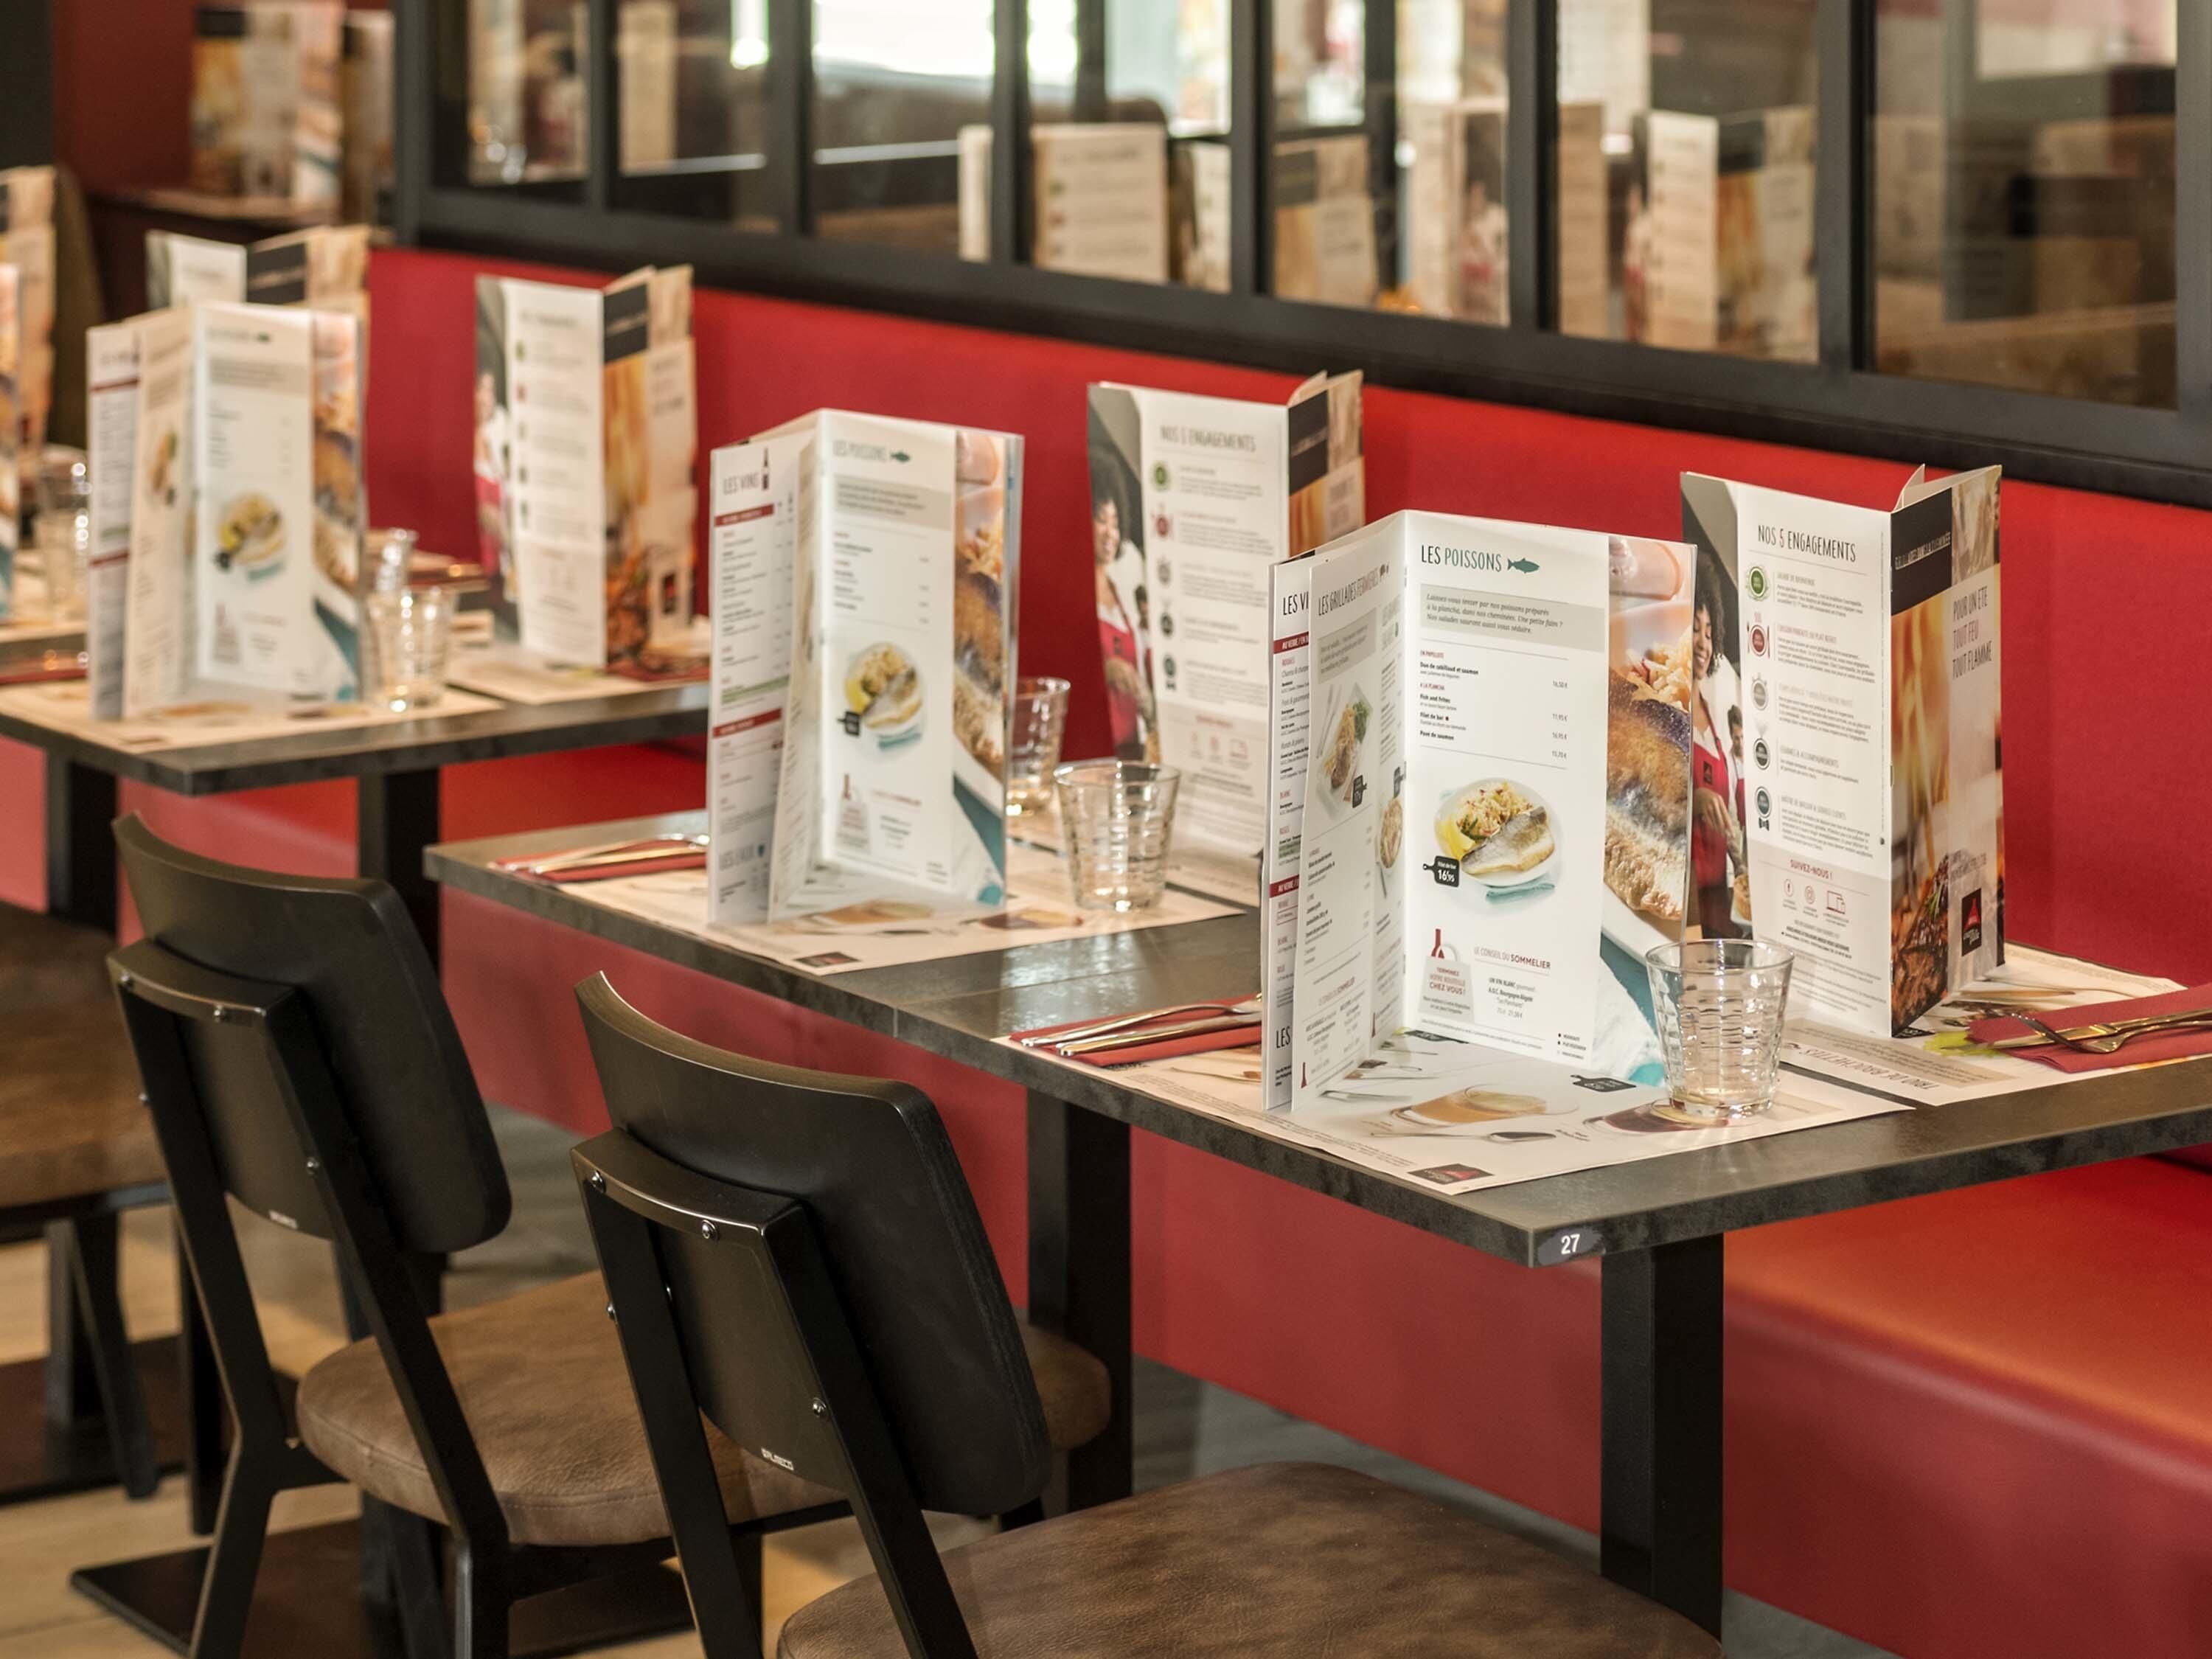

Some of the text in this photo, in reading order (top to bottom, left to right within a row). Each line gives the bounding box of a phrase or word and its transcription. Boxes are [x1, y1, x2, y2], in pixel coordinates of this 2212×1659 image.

[1758, 525, 1856, 563] NOS 5 ENGAGEMENTS
[1422, 545, 1502, 572] LES POISSONS
[1283, 591, 1309, 616] LES VI
[1318, 594, 1329, 616] LES
[1329, 581, 1357, 611] GRILLADES
[1953, 594, 1967, 622] POUR
[1952, 625, 1966, 652] TOUT
[1952, 640, 1993, 681] TOUT FLAMME
[1790, 859, 1829, 879] SUIVEZ-NOUS
[1511, 954, 1551, 970] SOMMELIER
[1429, 981, 1445, 992] CHEZ
[1447, 985, 1463, 995] VOUS
[1276, 1026, 1291, 1049] LES
[1561, 1233, 1580, 1255] 27
